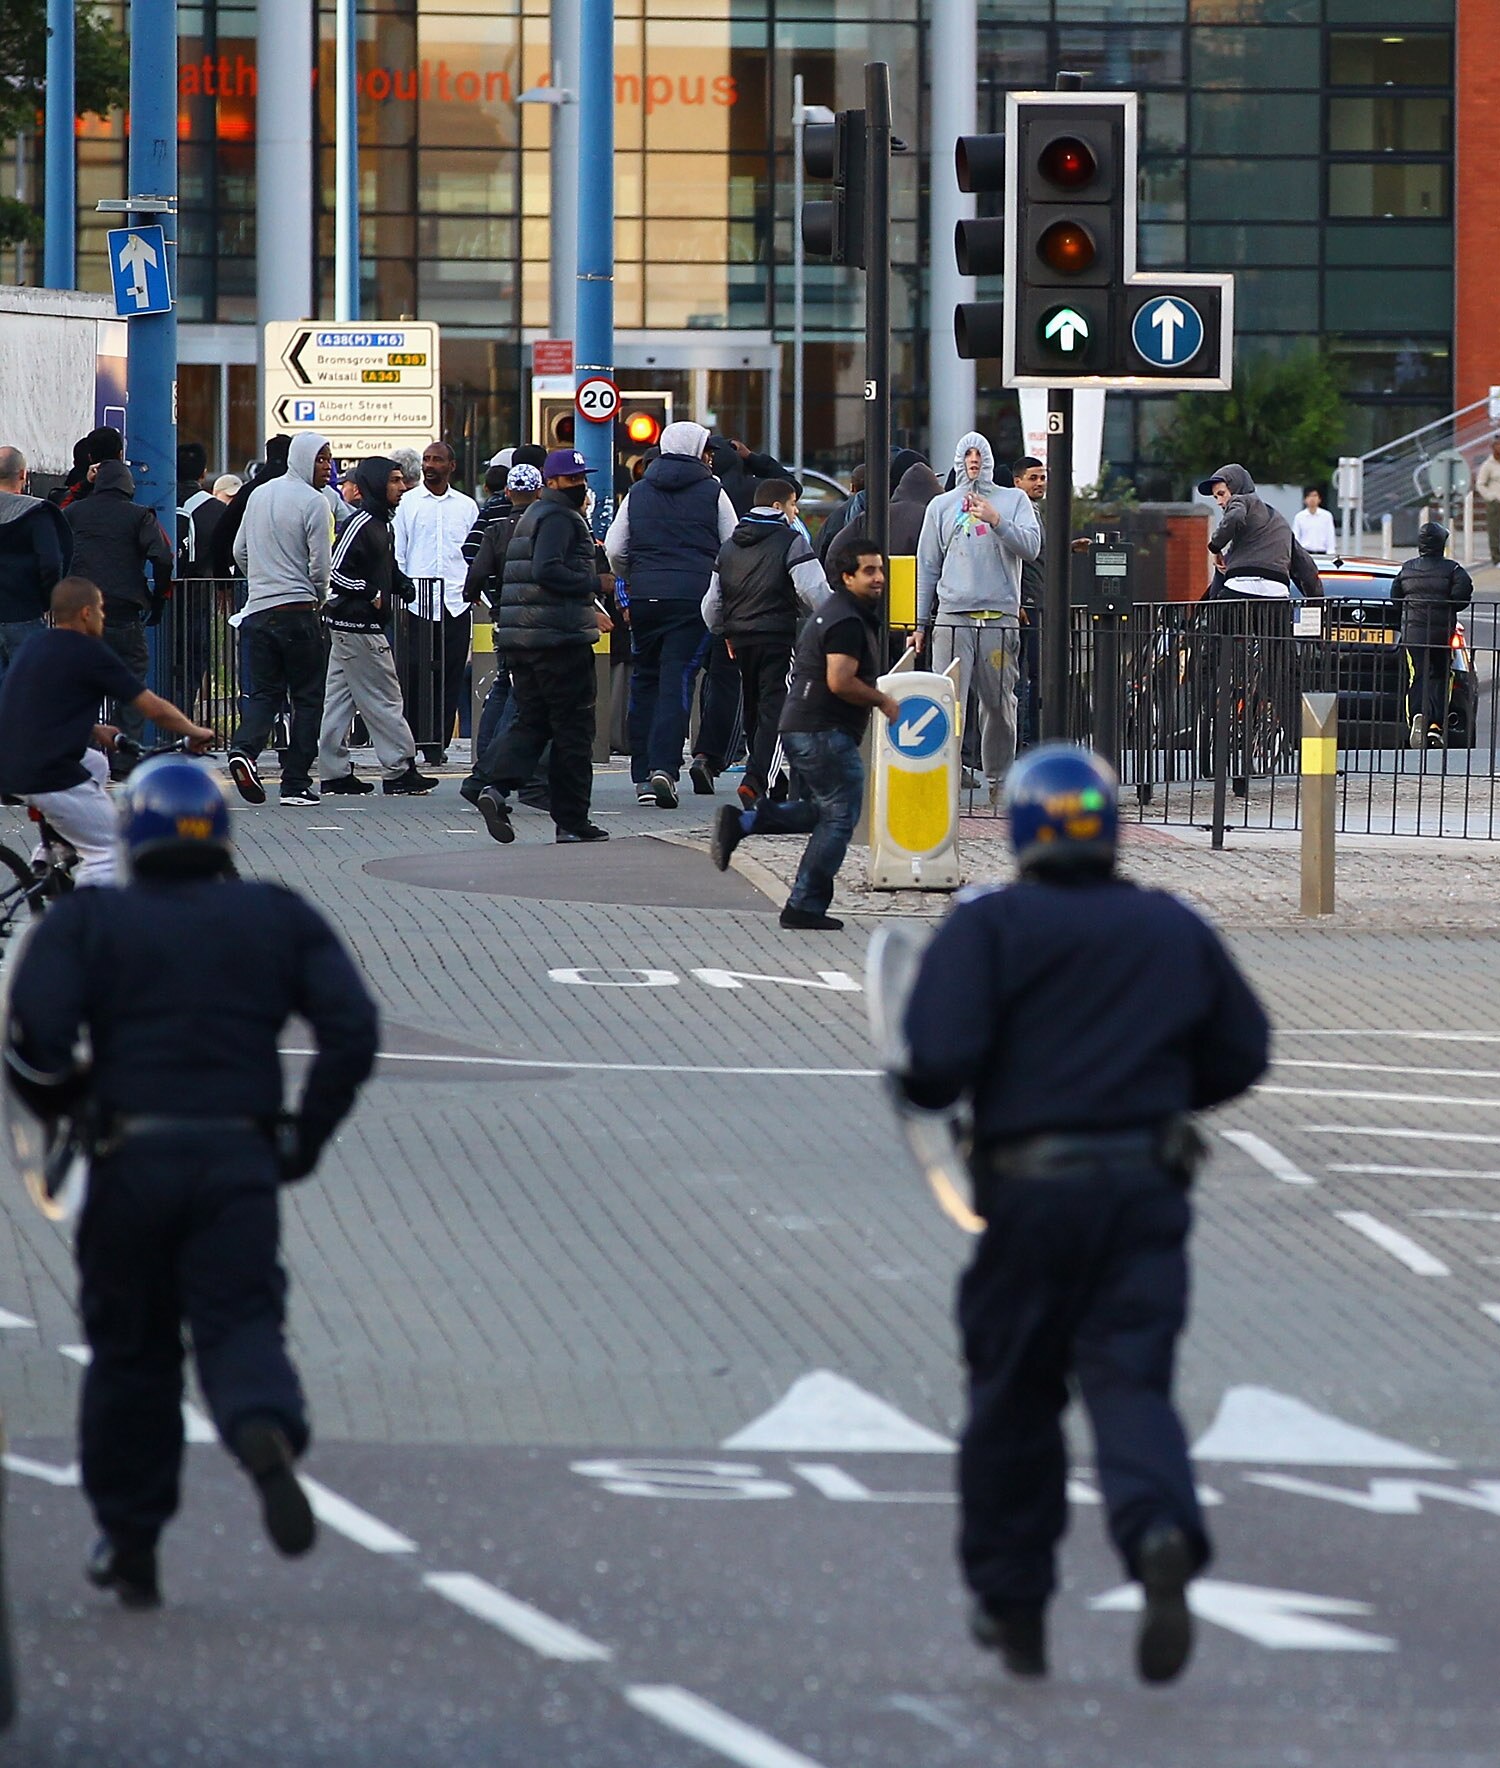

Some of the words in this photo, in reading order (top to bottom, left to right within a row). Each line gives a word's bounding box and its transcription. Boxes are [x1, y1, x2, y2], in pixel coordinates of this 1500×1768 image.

[317, 334, 372, 347] (A38(M)
[377, 334, 404, 347] M6)
[317, 355, 384, 365] Bromsgrove
[317, 371, 358, 381] Walsall
[362, 370, 401, 382] (A34)
[319, 401, 353, 410] Albert
[358, 401, 393, 410] Street
[583, 391, 615, 409] 20
[319, 413, 389, 423] Londonderry
[394, 413, 428, 421] House
[1048, 414, 1060, 432] 6
[332, 441, 353, 450] Law
[357, 441, 393, 450] Courts
